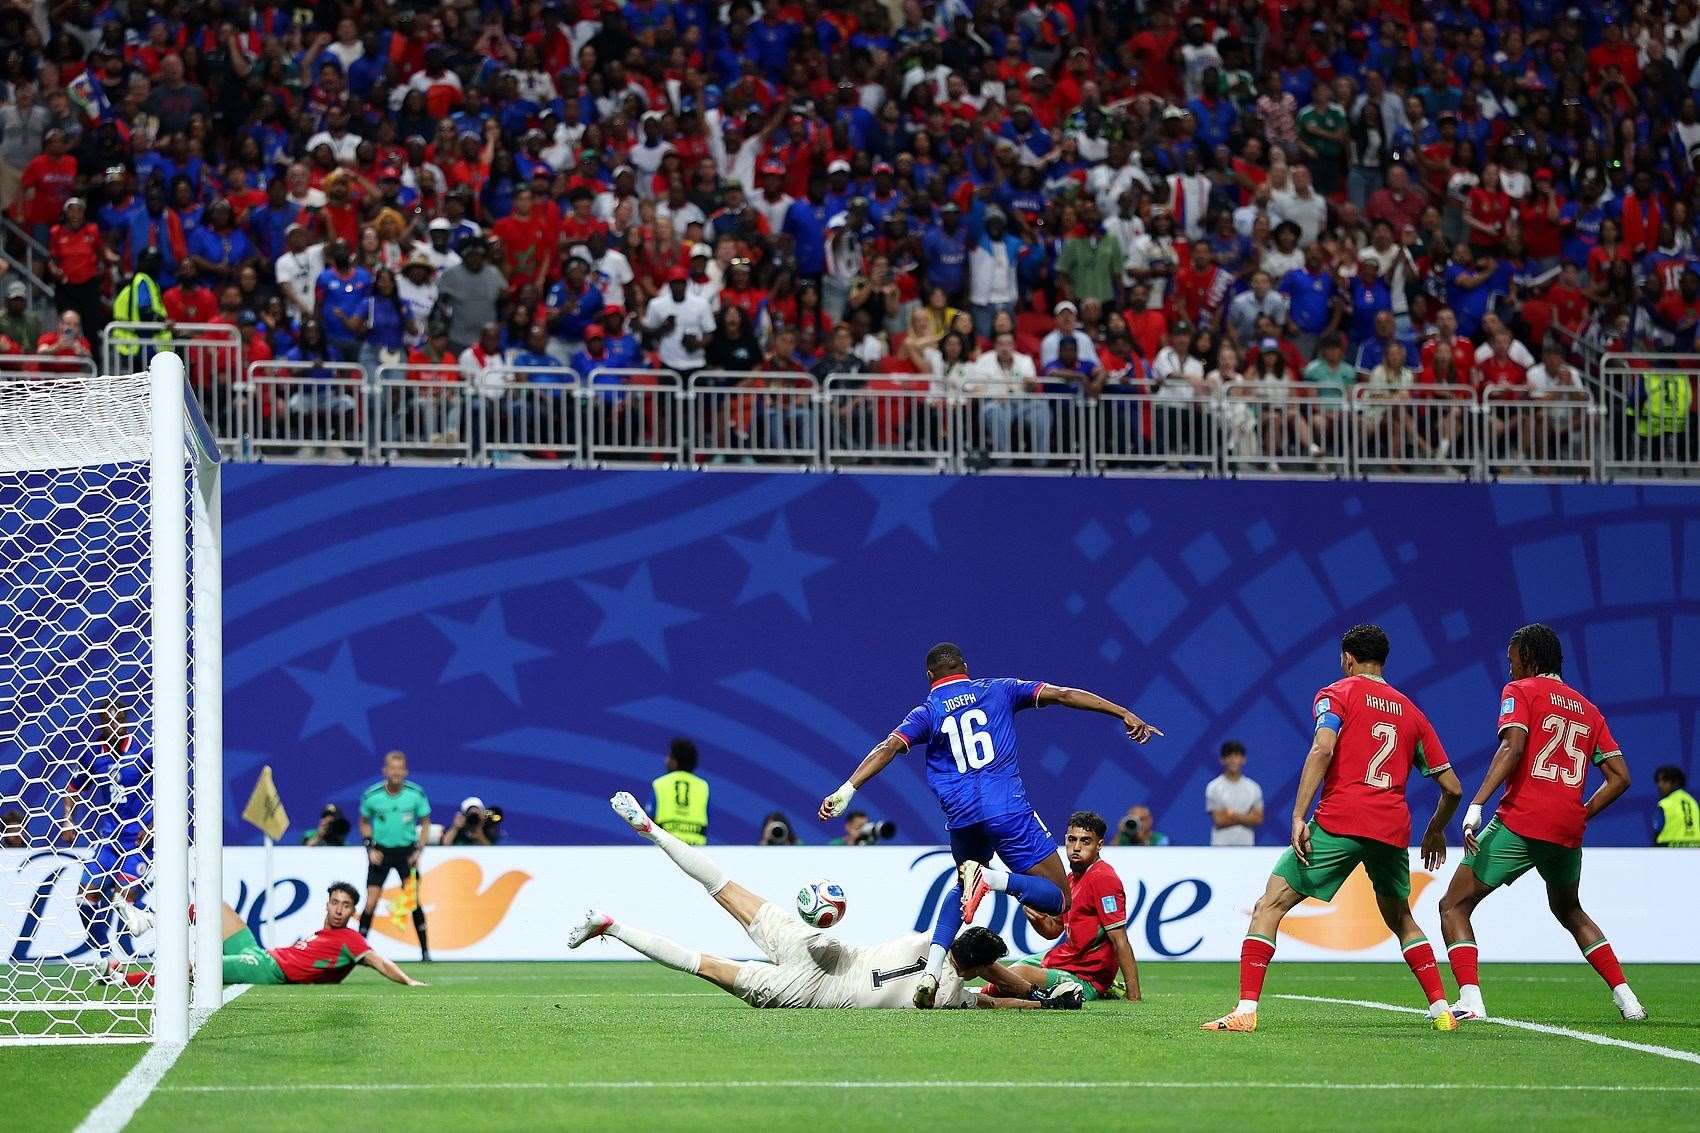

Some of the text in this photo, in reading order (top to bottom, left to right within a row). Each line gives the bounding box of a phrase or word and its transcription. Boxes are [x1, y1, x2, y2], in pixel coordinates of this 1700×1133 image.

[942, 693, 977, 713] JOSEPH
[1366, 694, 1403, 716] HAKIMI
[1550, 692, 1585, 715] HALHAL
[941, 708, 996, 774] 16
[1364, 721, 1398, 790] 2
[1531, 713, 1591, 788] 25
[871, 955, 929, 992] 1
